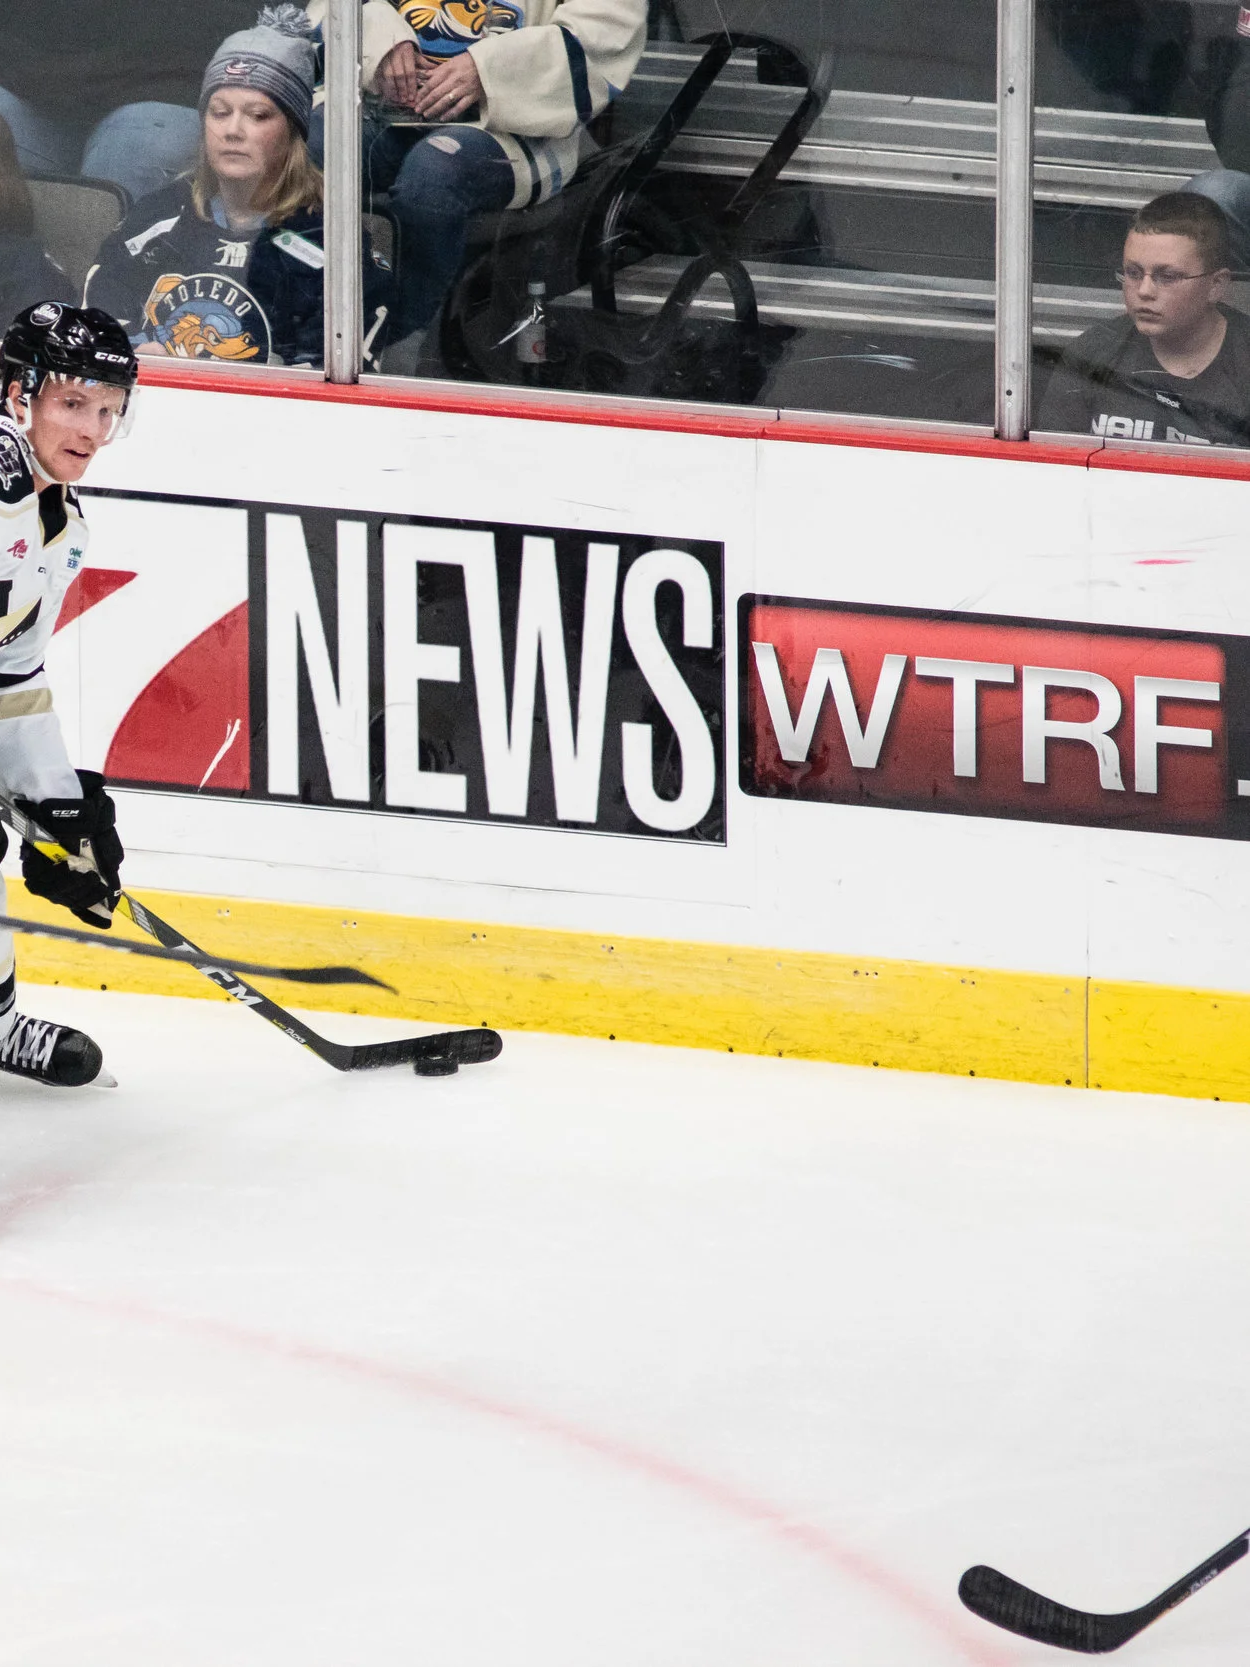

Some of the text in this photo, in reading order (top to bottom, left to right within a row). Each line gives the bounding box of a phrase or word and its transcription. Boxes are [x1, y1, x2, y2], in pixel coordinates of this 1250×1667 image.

[163, 279, 253, 317] TOLEDO
[94, 351, 130, 364] CCM
[265, 512, 715, 833] NEWS
